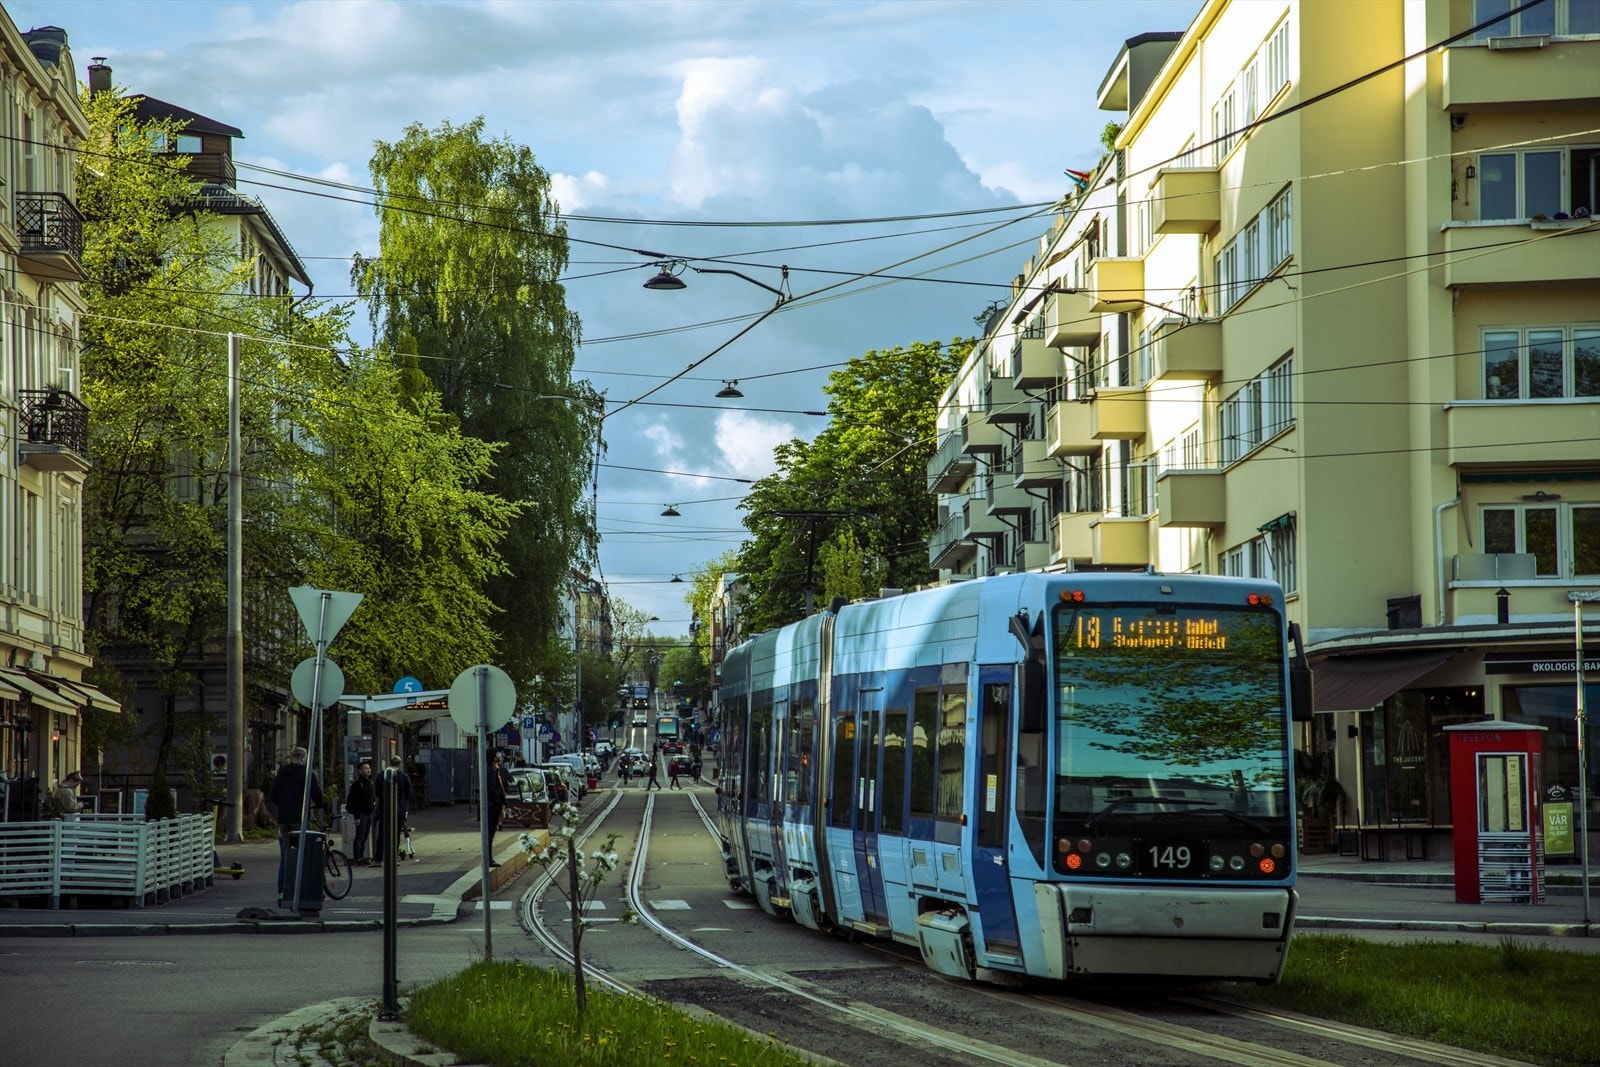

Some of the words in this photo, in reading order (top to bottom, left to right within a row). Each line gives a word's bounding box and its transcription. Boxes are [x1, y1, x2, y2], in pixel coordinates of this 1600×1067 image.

[1532, 662, 1577, 673] ØKOLOGIS
[404, 681, 414, 692] 5
[525, 719, 532, 728] P
[1457, 733, 1502, 743] TELEFON
[1549, 813, 1567, 826] VÅR
[1149, 845, 1192, 869] 149
